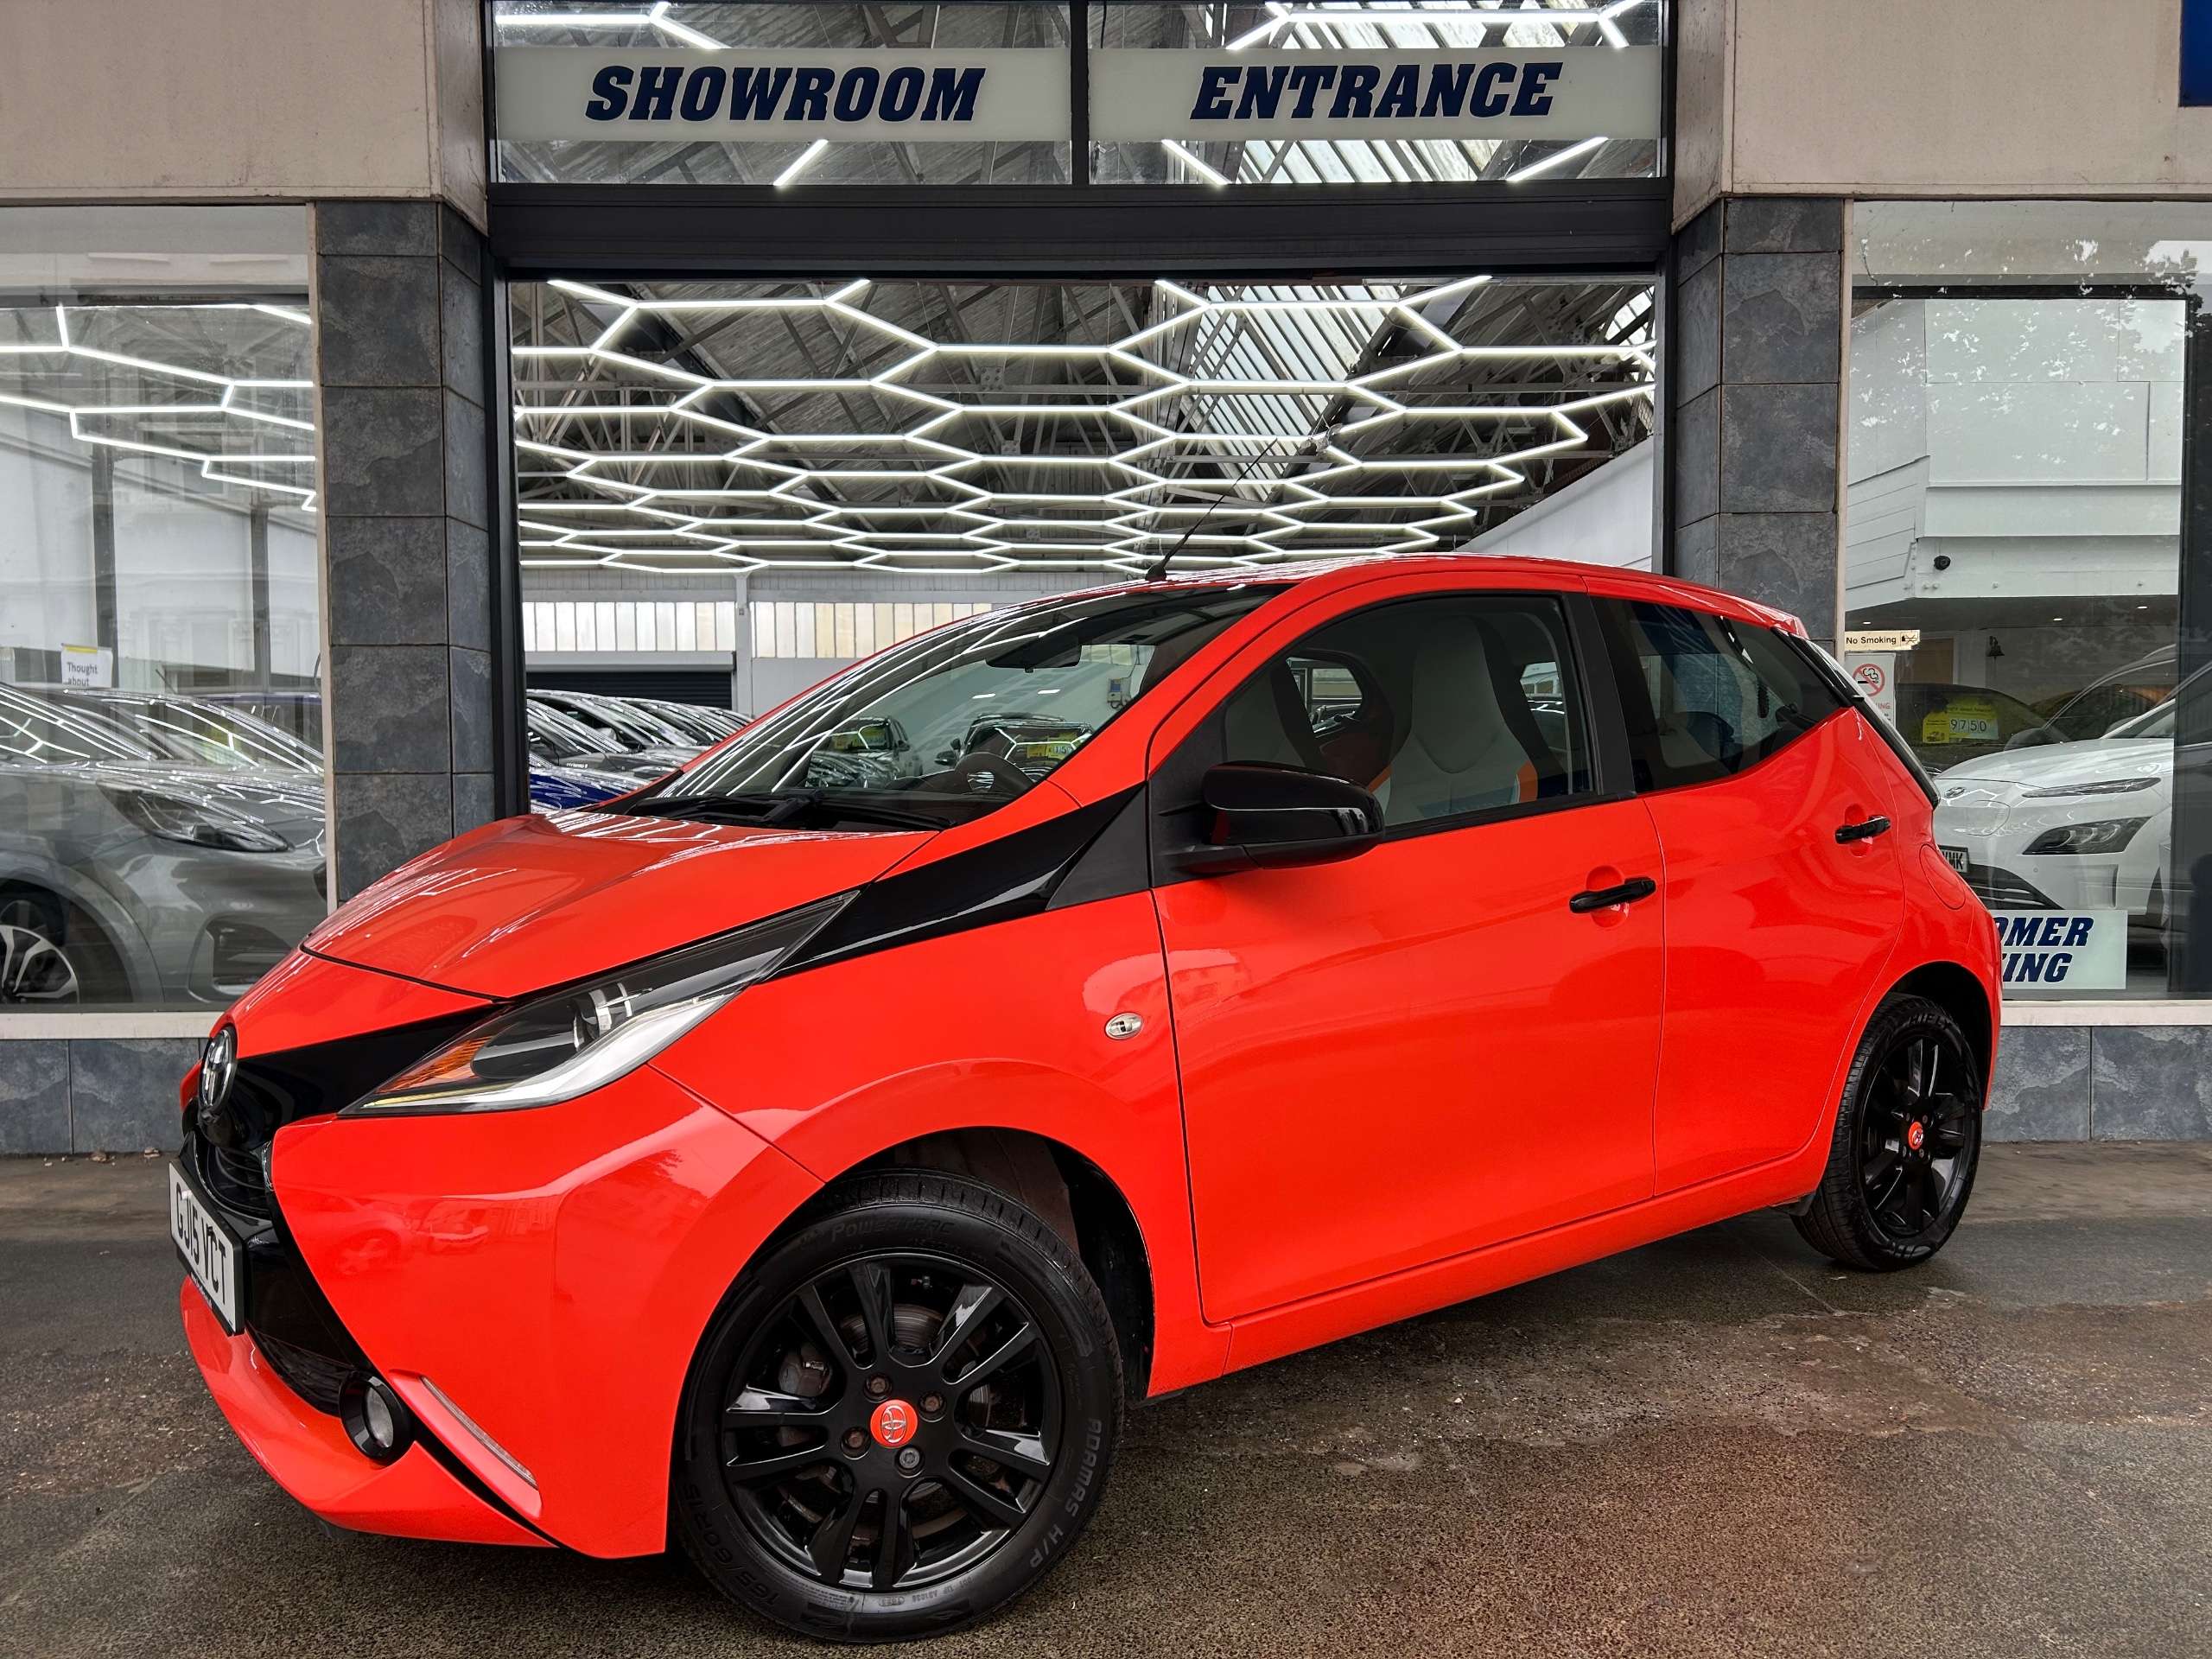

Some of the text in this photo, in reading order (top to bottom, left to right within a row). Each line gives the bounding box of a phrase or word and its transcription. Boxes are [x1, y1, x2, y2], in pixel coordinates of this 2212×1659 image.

[585, 66, 986, 121] SHOWROOM
[1190, 62, 1563, 119] ENTRANCE
[1860, 636, 1897, 645] Smoking
[67, 662, 98, 676] Thought
[67, 677, 89, 687] about
[1950, 719, 1986, 732] 9750
[2002, 952, 2073, 983] ING
[176, 1182, 200, 1266] GJ15
[200, 1216, 226, 1306] VCT
